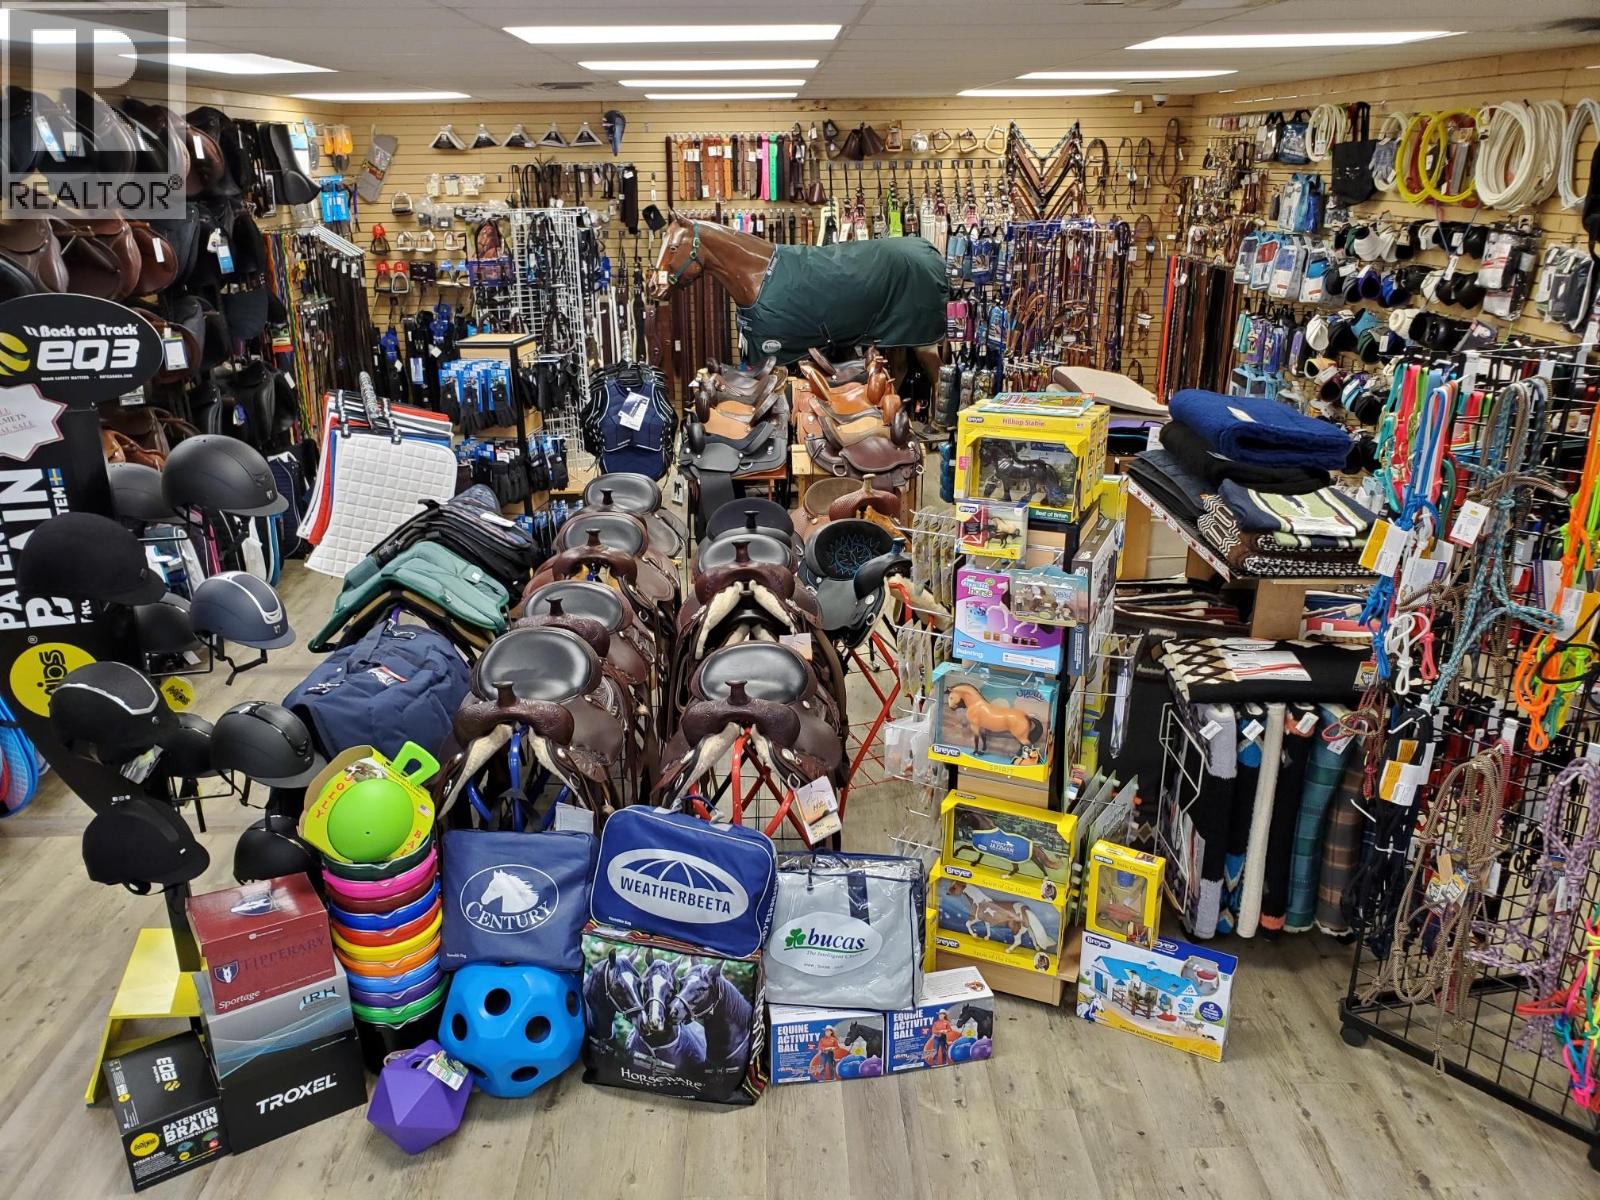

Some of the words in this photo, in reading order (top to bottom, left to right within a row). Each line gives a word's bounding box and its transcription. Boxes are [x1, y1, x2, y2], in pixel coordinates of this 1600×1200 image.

[39, 324, 76, 338] Back
[77, 326, 97, 337] on
[97, 323, 139, 337] Track
[1035, 510, 1048, 518] Best
[37, 649, 68, 695] ips
[933, 745, 959, 756] Breyer
[989, 763, 1015, 774] SPIRIT
[946, 866, 971, 877] Breyer
[620, 876, 731, 914] WEATHERBEETA
[465, 901, 551, 930] CENTURY
[807, 928, 866, 950] bucas
[1086, 937, 1110, 949] Breyer
[239, 936, 325, 970] TIPPERARY
[218, 990, 261, 1011] Sportage
[302, 986, 336, 1004] IRH
[894, 1009, 924, 1022] EQUINE
[777, 1023, 809, 1036] EQUINE
[894, 1016, 935, 1031] ACTIVITY
[777, 1032, 821, 1044] ACTIVITY
[893, 1029, 914, 1040] BALL
[777, 1043, 800, 1053] BALL
[256, 1073, 336, 1115] TROXEL
[162, 1106, 217, 1131] PATENTED
[163, 1113, 219, 1144] BRAIN
